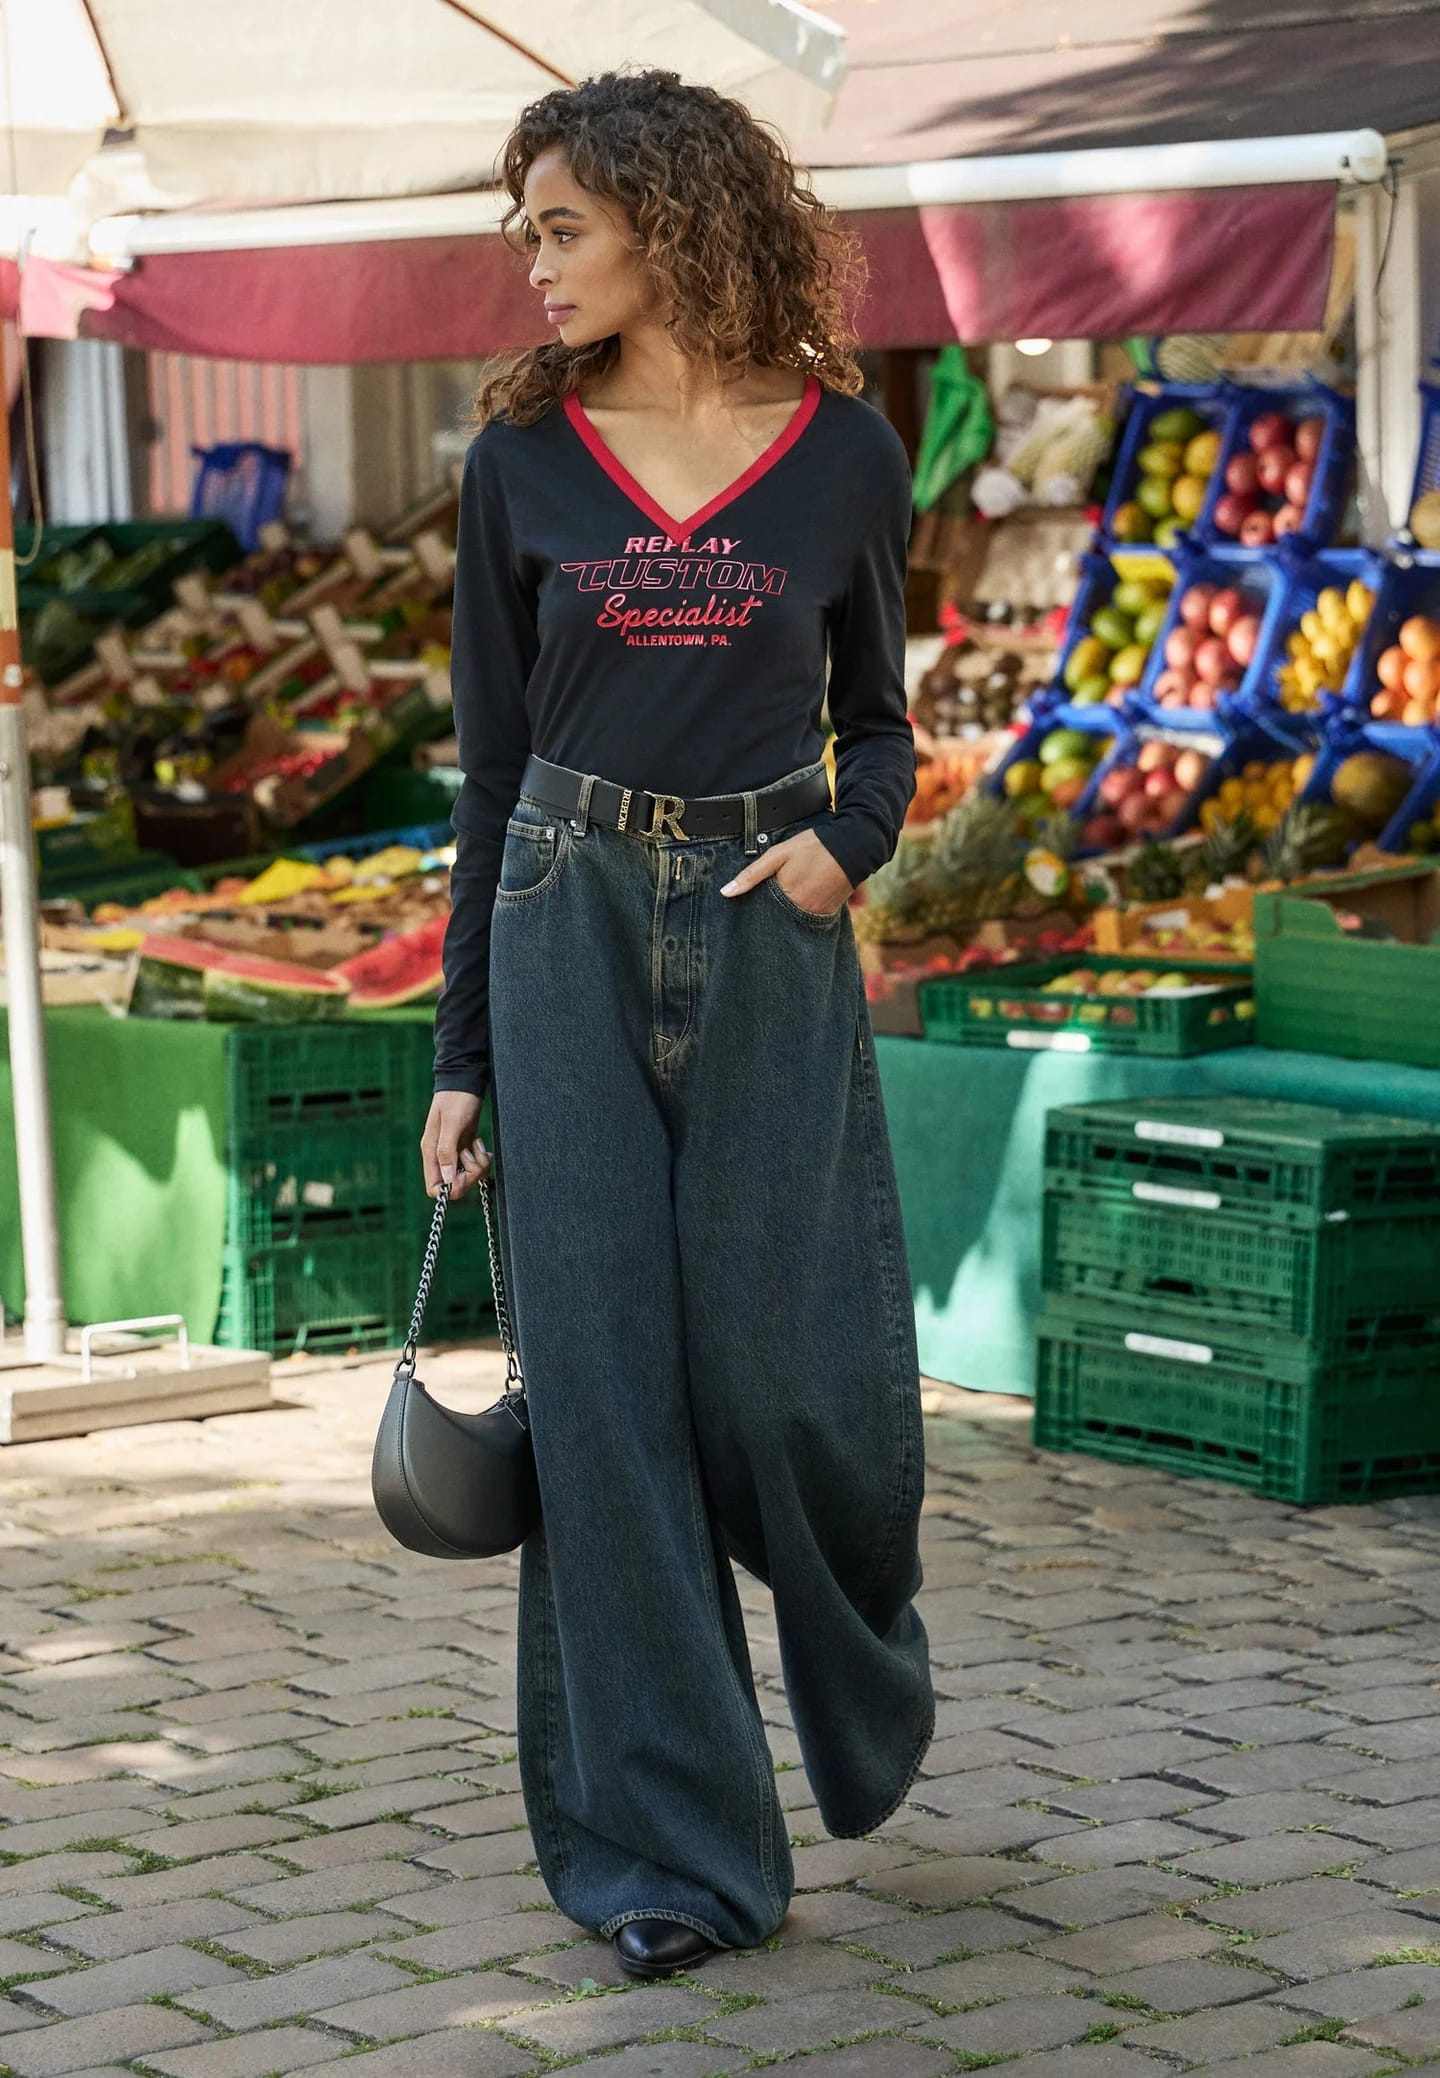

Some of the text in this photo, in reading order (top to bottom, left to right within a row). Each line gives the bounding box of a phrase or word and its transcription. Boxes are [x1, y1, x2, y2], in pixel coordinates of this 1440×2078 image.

[560, 558, 788, 595] CUSTOM
[596, 593, 763, 636] Specialist
[626, 634, 732, 647] ALLENTOWN, PA.
[645, 792, 690, 841] R
